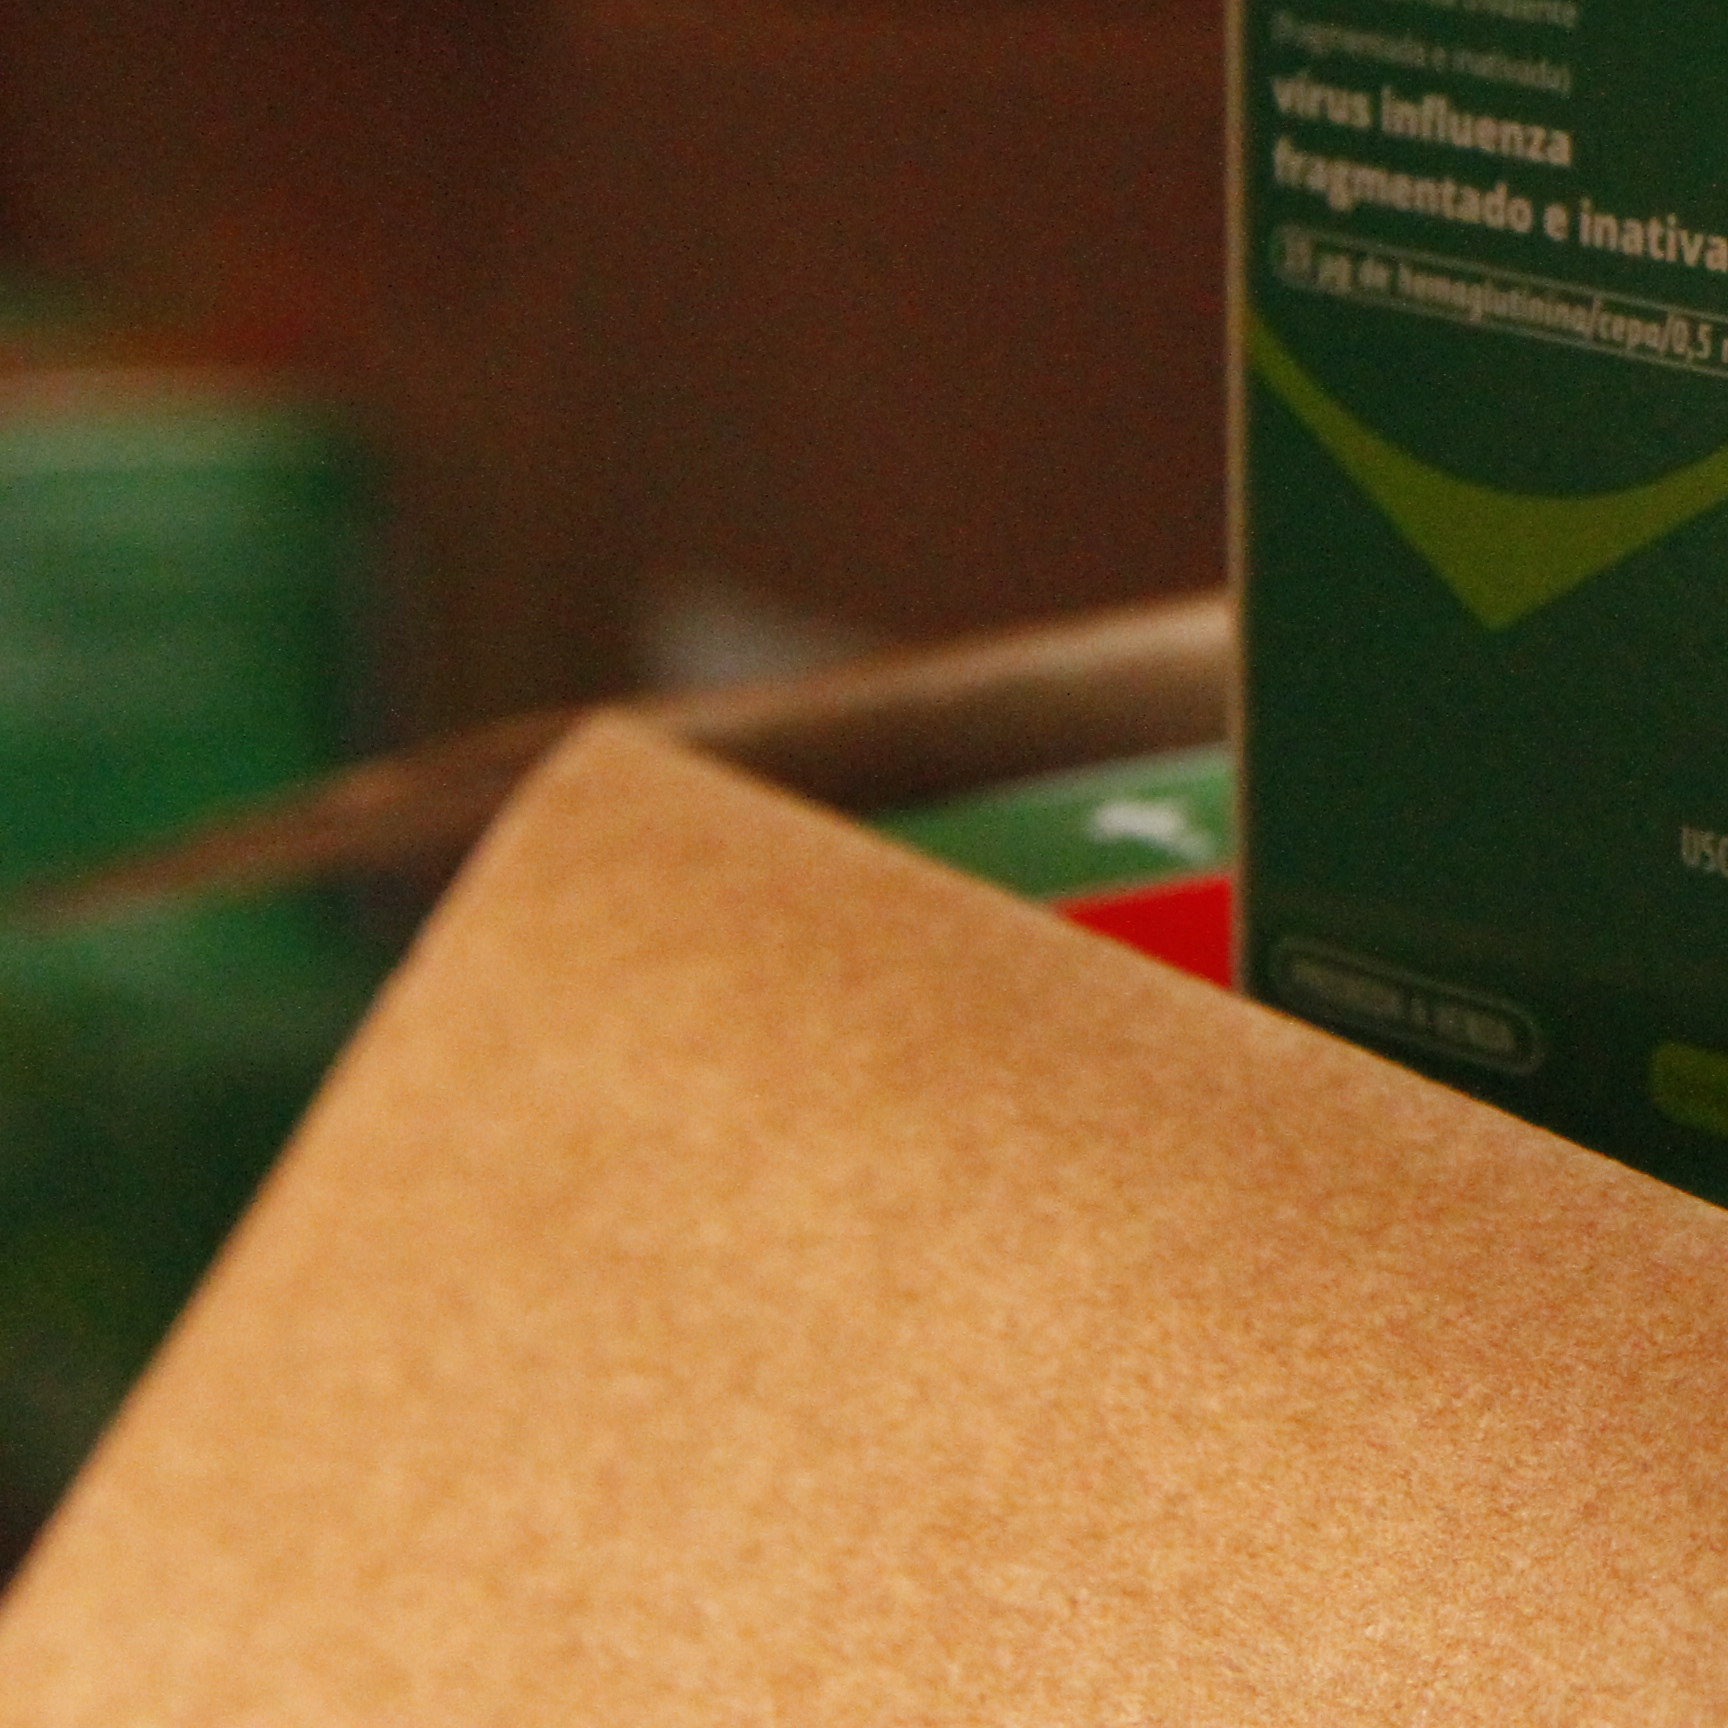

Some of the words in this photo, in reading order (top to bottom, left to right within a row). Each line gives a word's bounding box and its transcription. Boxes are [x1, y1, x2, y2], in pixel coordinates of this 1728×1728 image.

[1380, 84, 1572, 166] influenza
[1273, 136, 1534, 233] fragmentado
[1543, 202, 1569, 242] e
